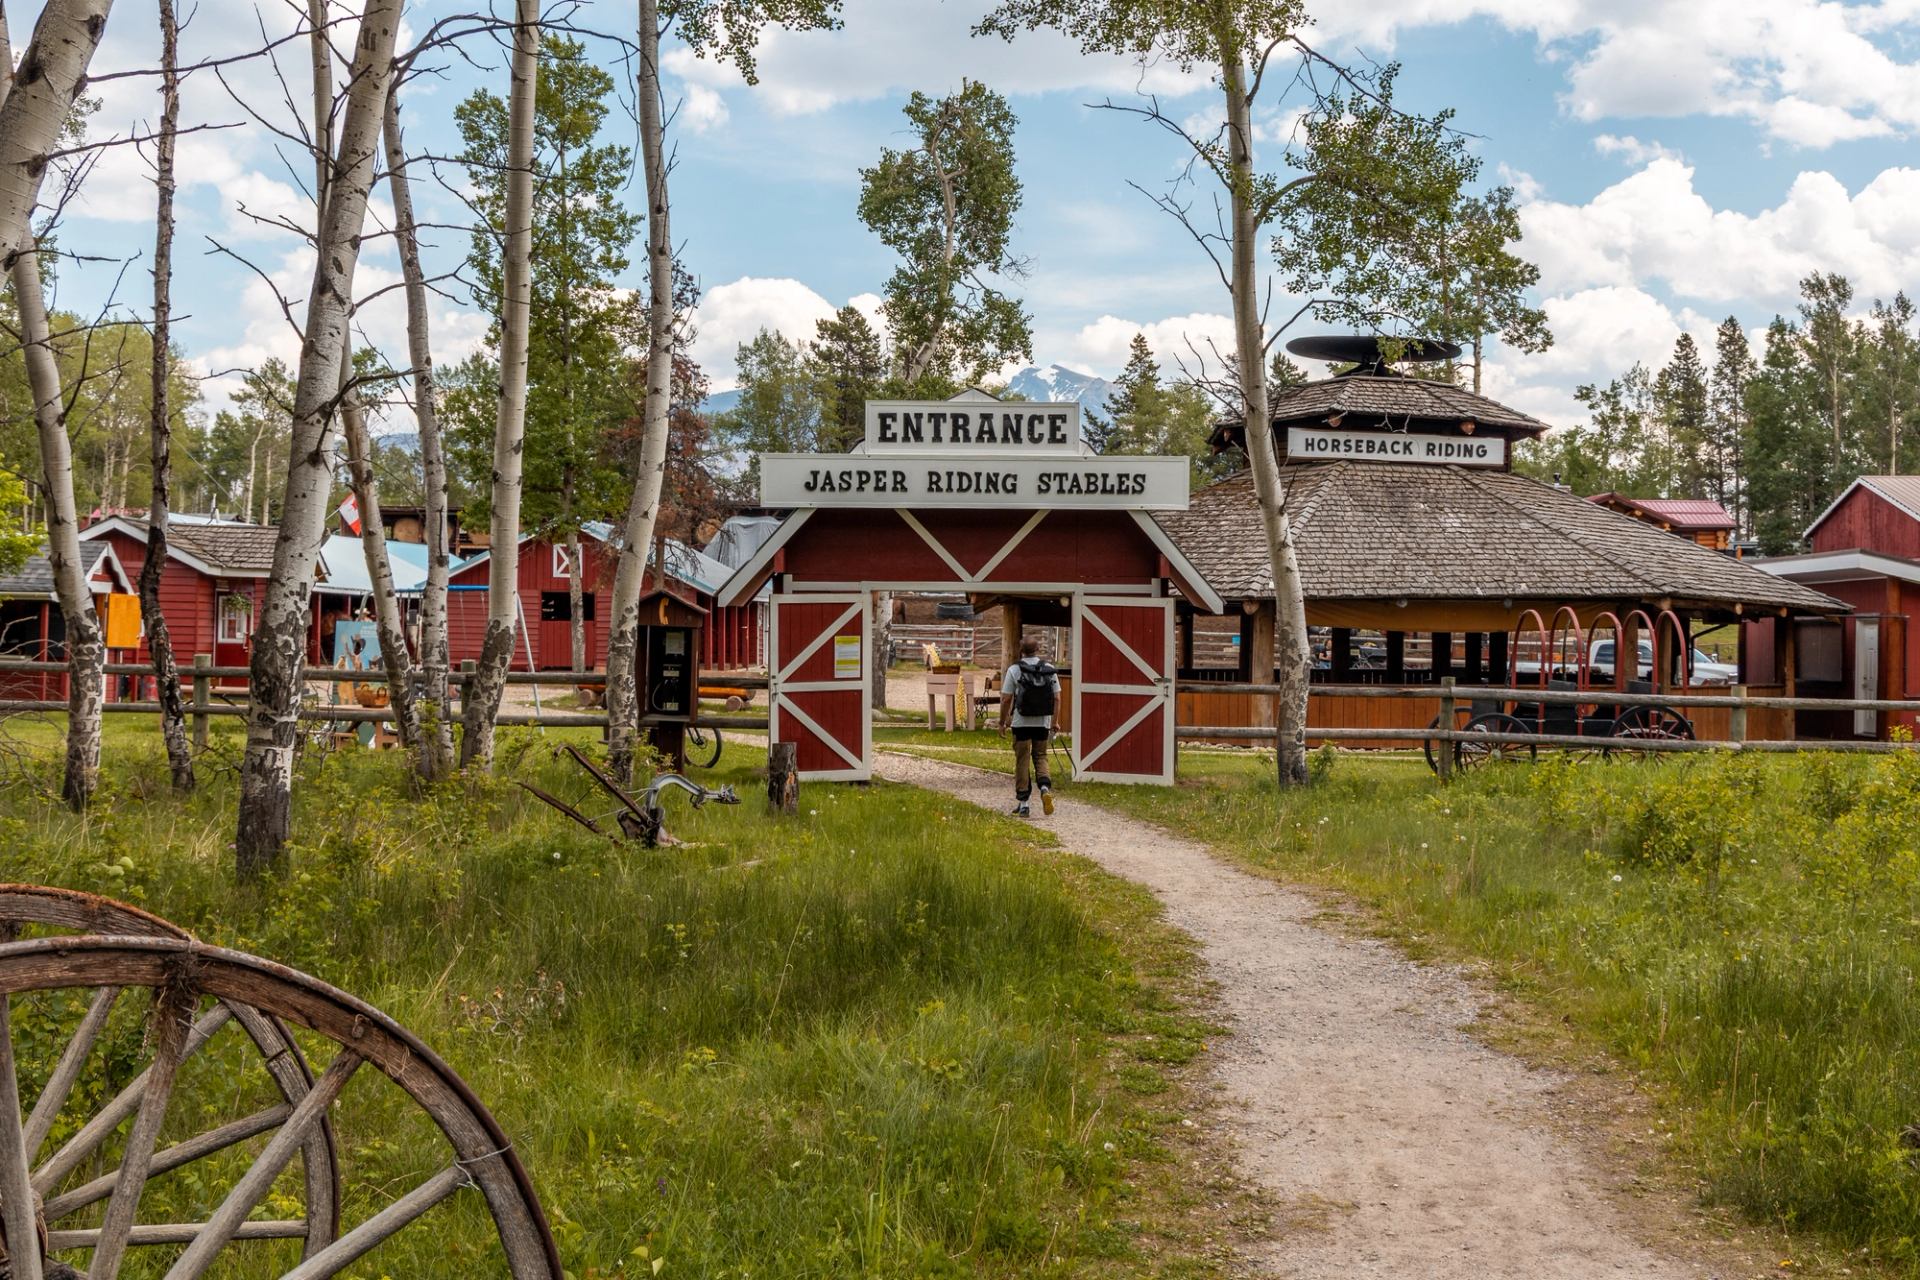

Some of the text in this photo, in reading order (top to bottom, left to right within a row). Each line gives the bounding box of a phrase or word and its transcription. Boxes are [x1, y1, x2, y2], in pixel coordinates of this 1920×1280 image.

[878, 412, 1067, 444] ENTRANCE
[1304, 437, 1488, 458] HORSEBACK RIDING
[804, 470, 1147, 495] JASPER RIDING STABLES
